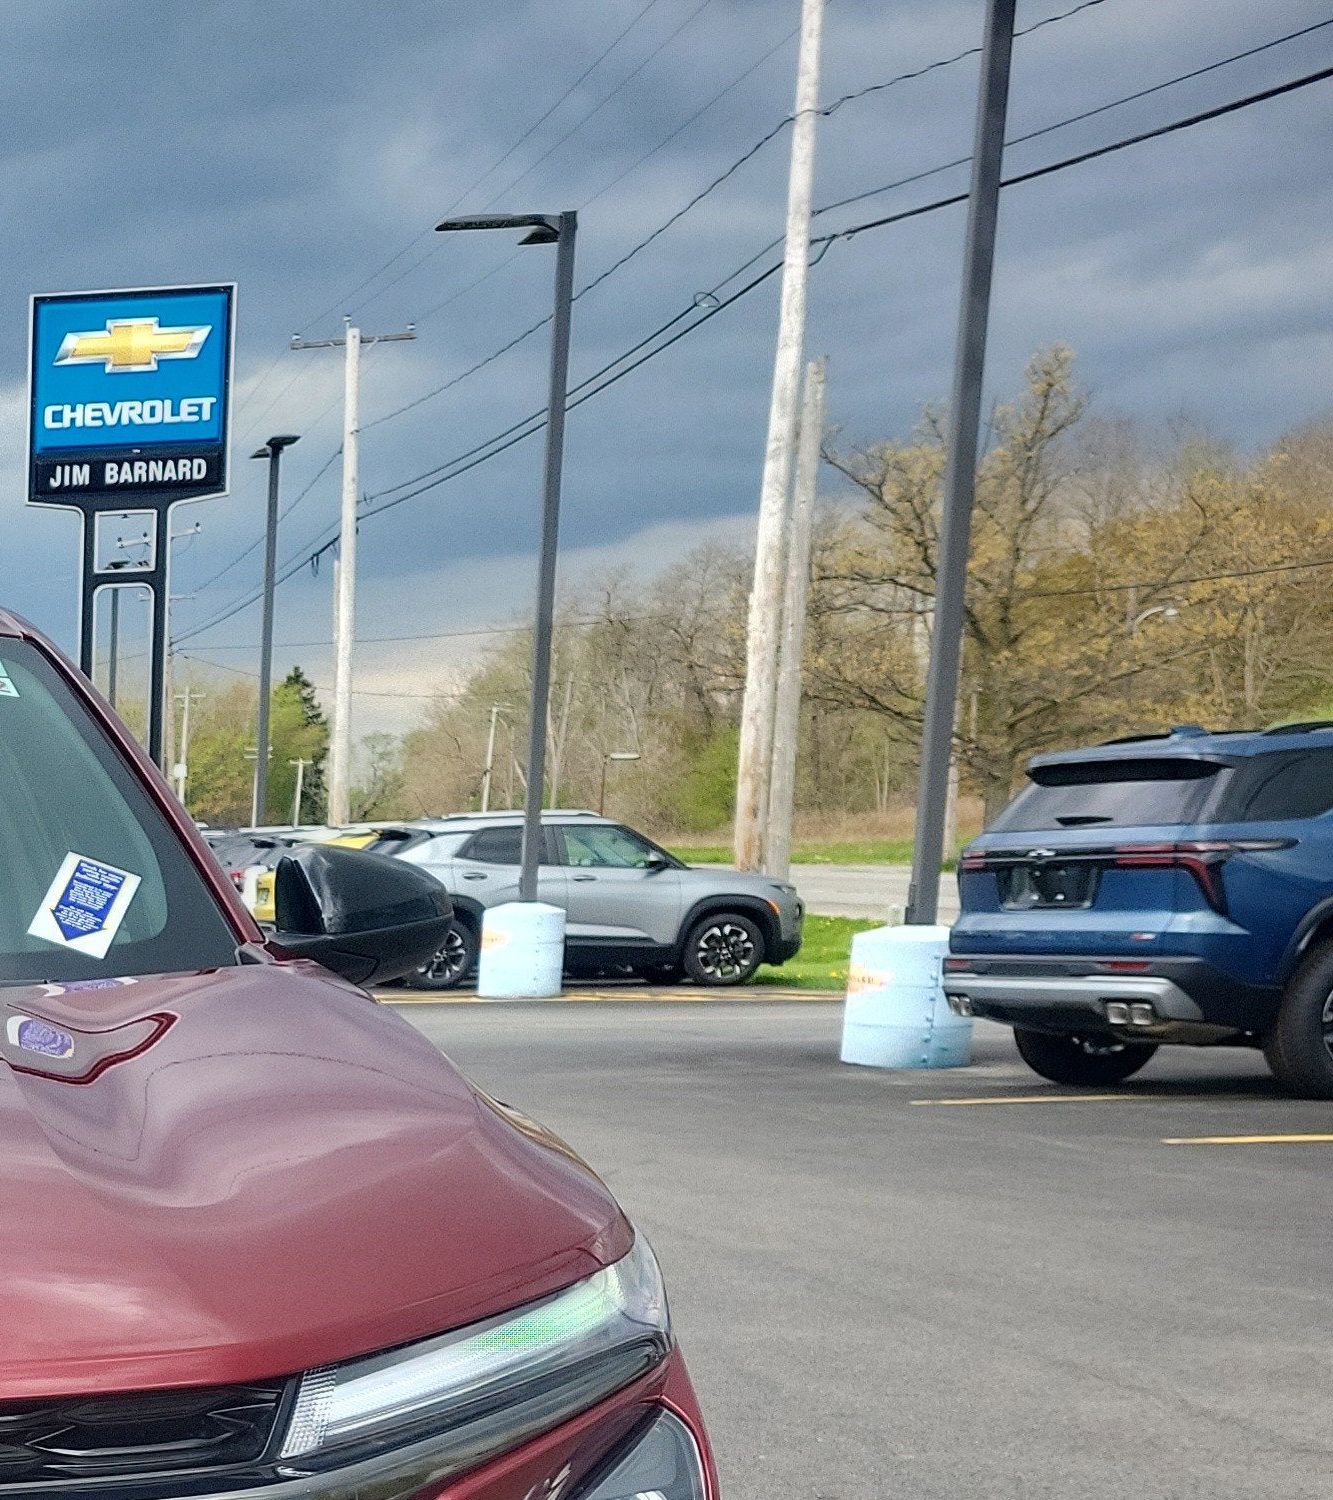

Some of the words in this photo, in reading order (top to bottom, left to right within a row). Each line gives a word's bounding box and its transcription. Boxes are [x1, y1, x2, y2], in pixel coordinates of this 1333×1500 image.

[43, 396, 217, 430] CHEVROLET
[49, 464, 90, 488] JIM
[104, 458, 207, 486] BARNARD
